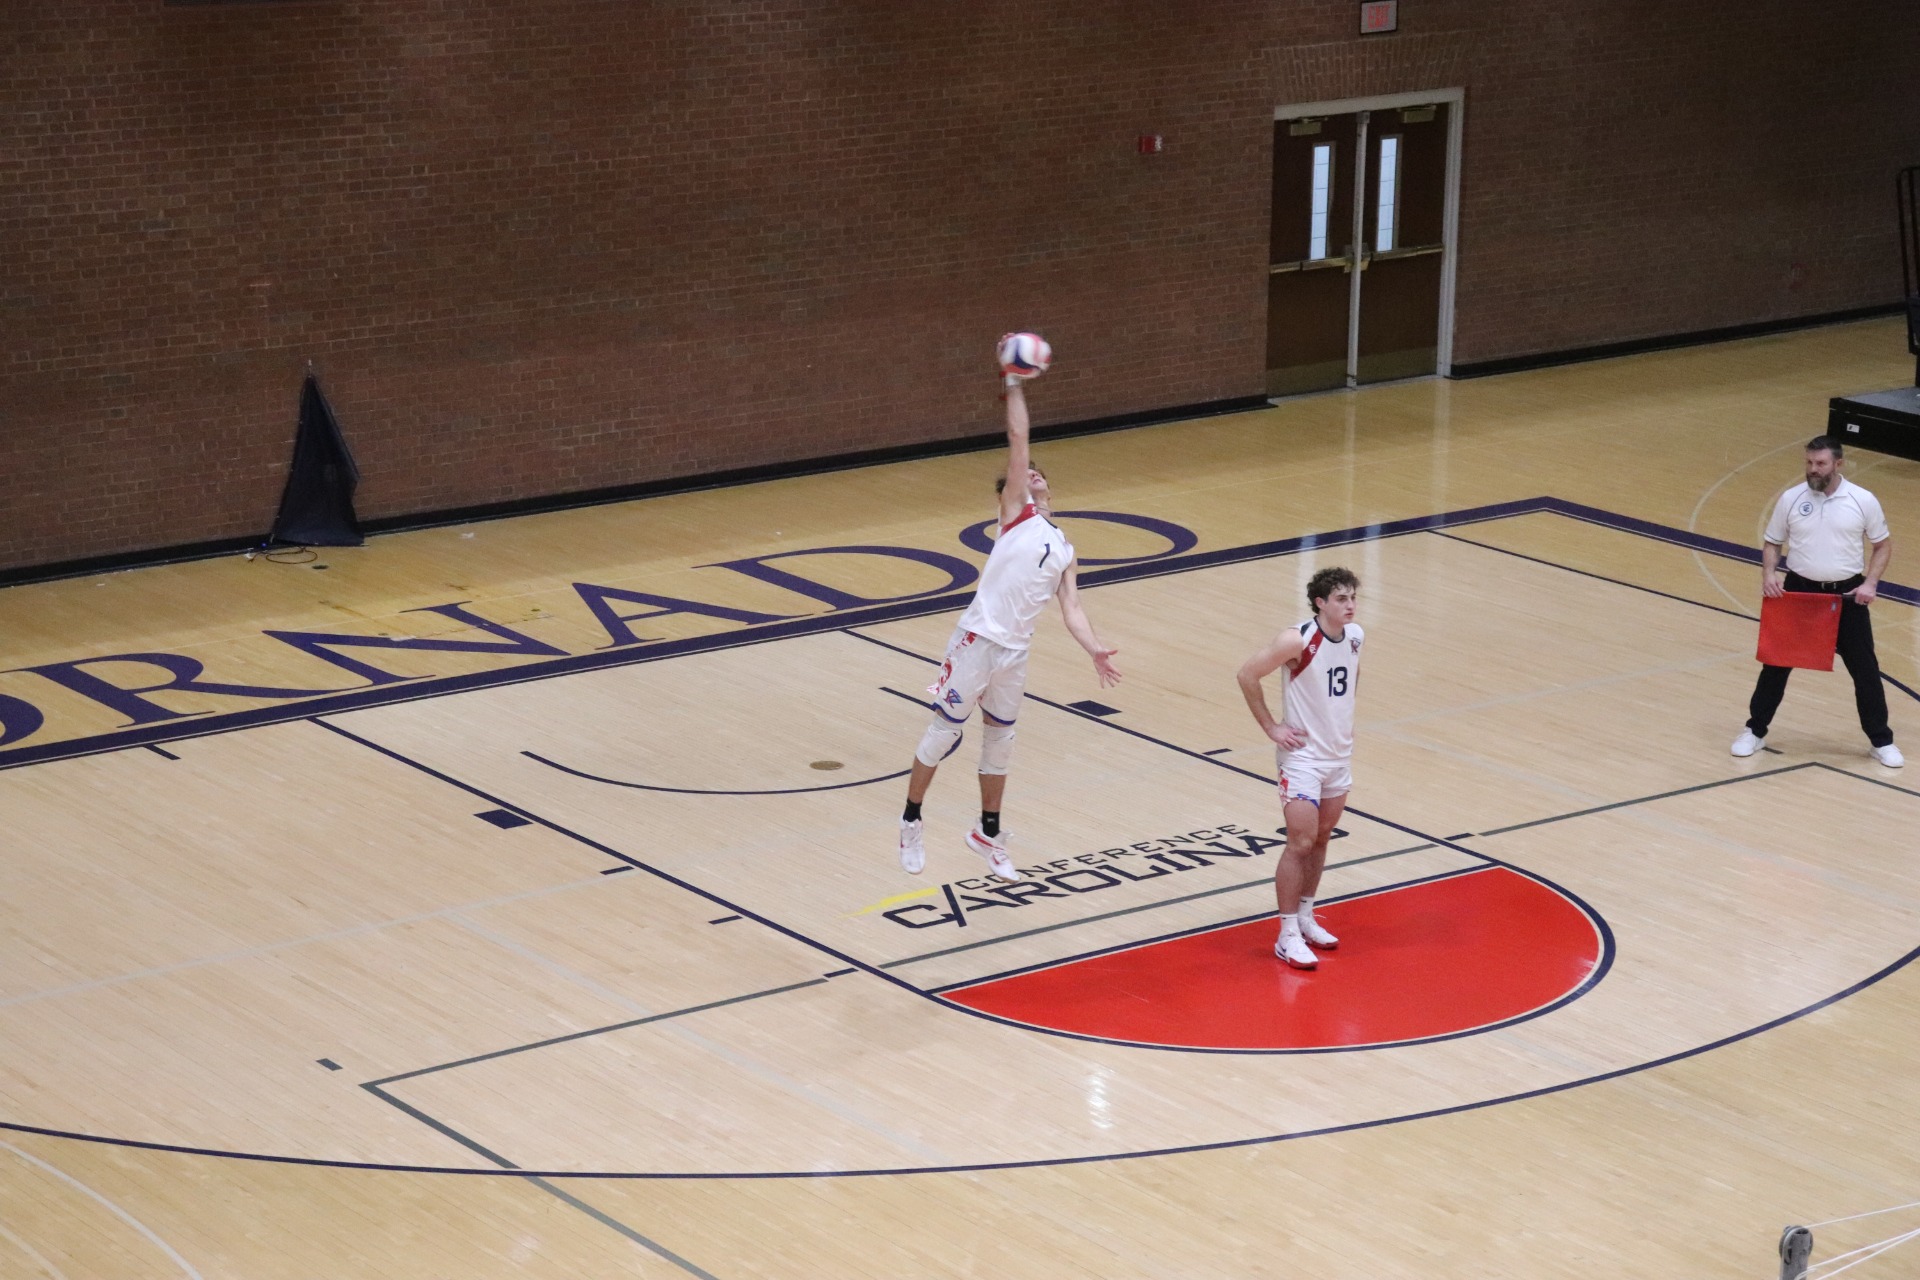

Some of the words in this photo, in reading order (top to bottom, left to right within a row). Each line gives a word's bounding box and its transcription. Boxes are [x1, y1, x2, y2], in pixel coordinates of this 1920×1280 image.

[1038, 543, 1050, 569] 1
[0, 510, 1198, 746] RNADO
[1327, 666, 1348, 697] 13
